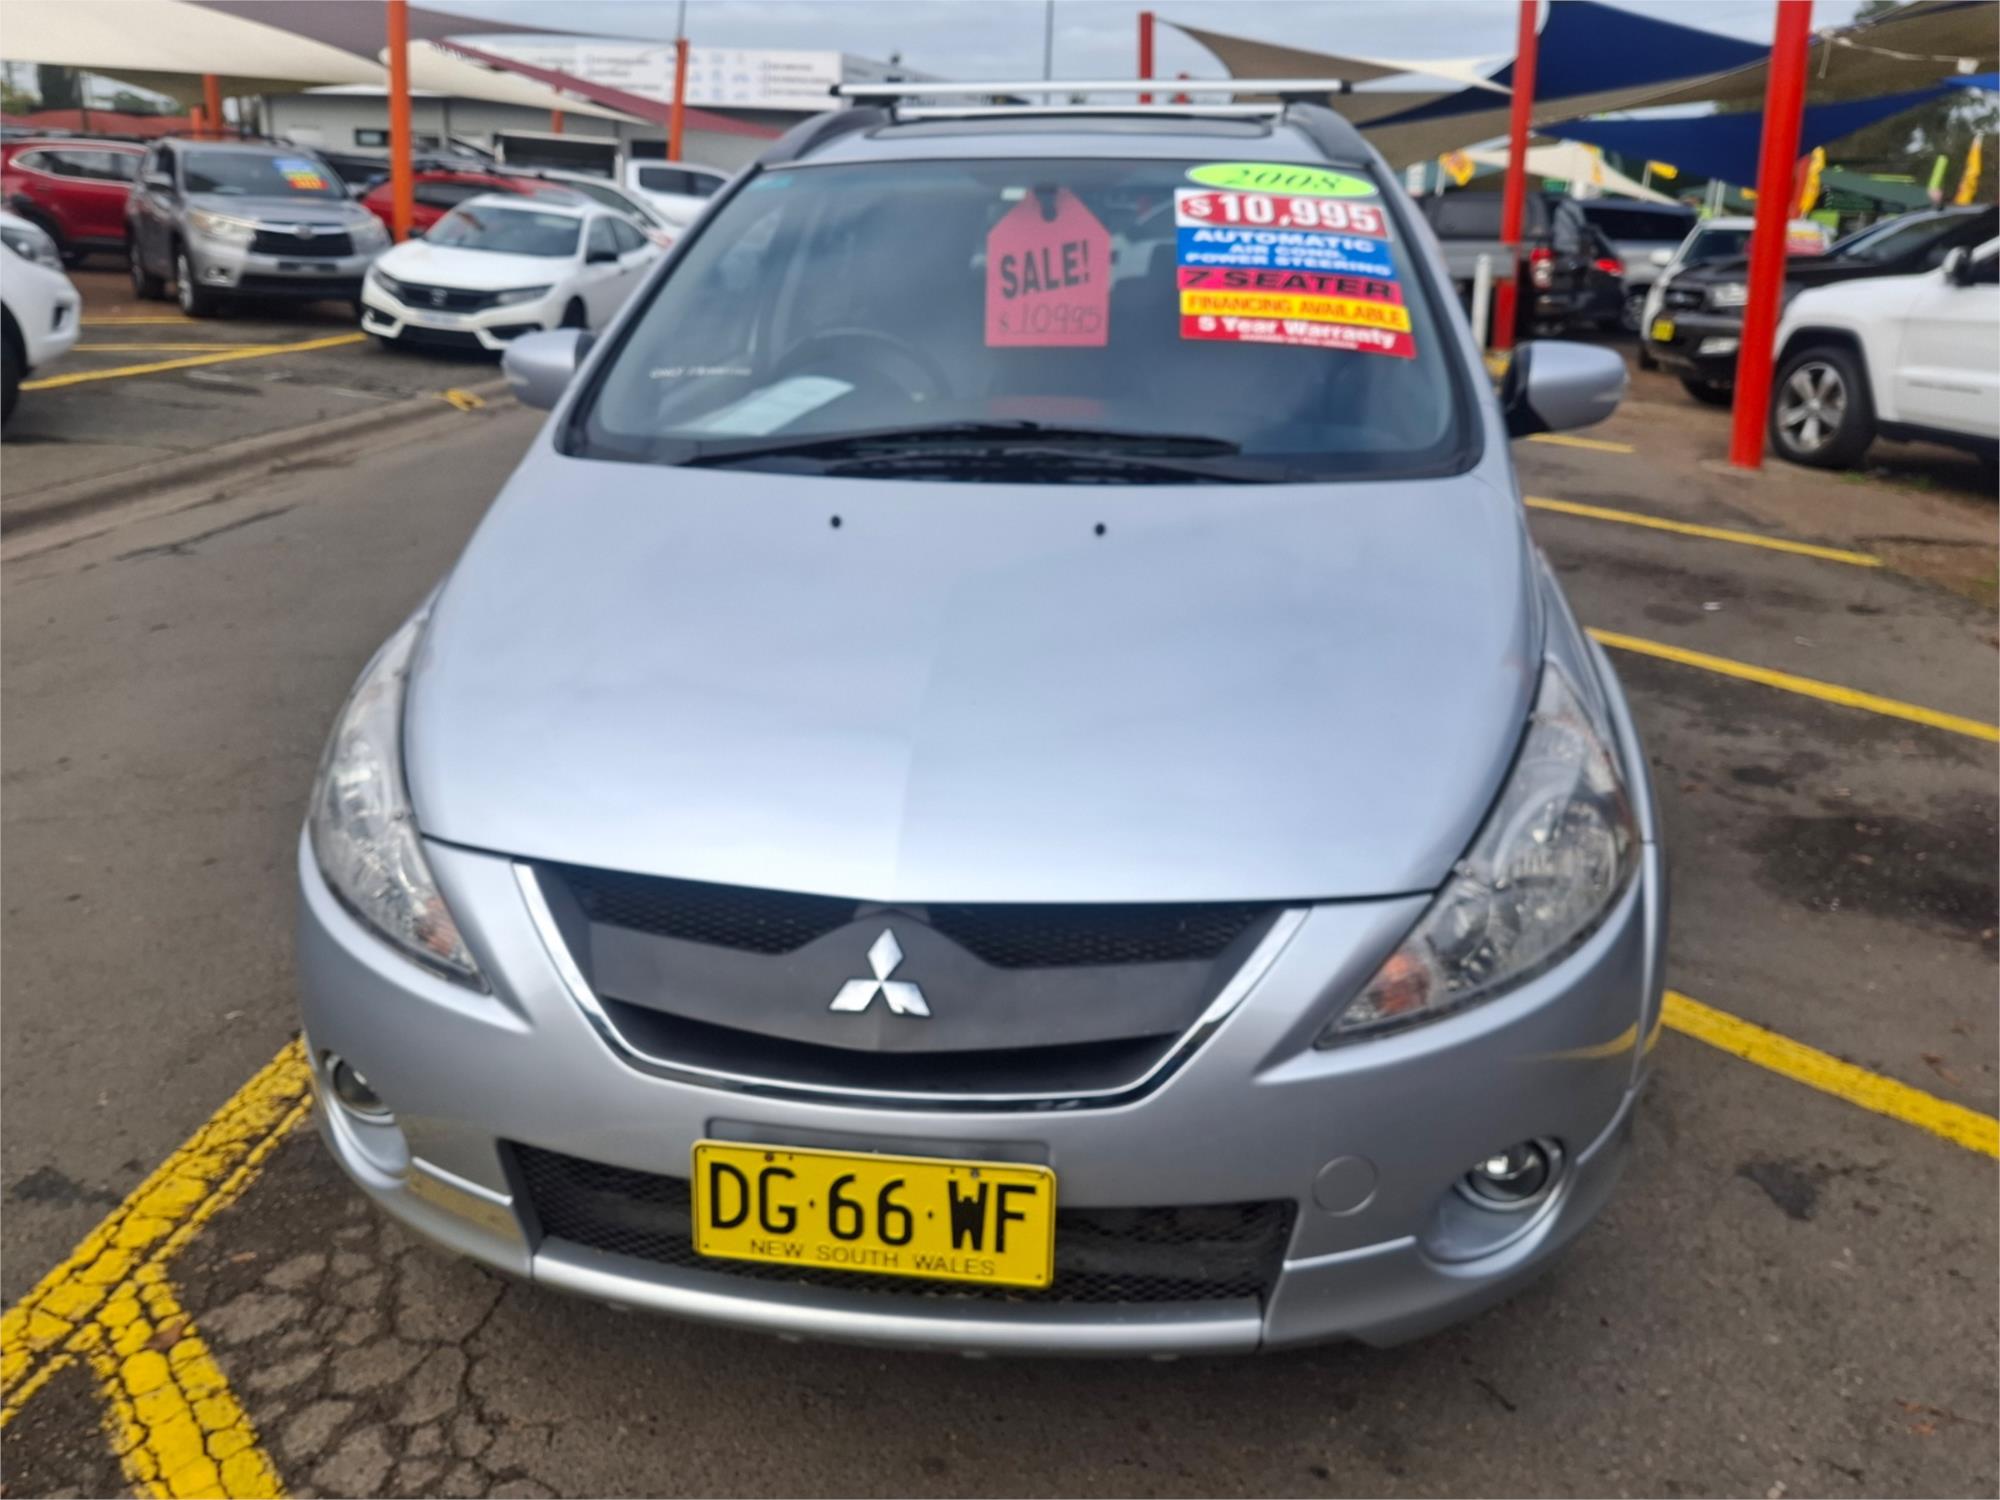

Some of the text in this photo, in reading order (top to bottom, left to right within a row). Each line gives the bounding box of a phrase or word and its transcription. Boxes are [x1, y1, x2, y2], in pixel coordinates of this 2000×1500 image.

[1221, 168, 1342, 190] 2008
[1184, 194, 1378, 233] $10,995
[1193, 229, 1375, 253] AUTOMATIC
[1000, 239, 1091, 300] SALE!
[1184, 252, 1393, 277] POWER STEERING
[1184, 270, 1391, 297] 7 SEATER
[1187, 295, 1402, 324] FINANCING AVAILABLE
[1220, 317, 1278, 334] Year
[1282, 320, 1397, 349] Warranty
[750, 1238, 995, 1276] NEW SOUTH WALES
